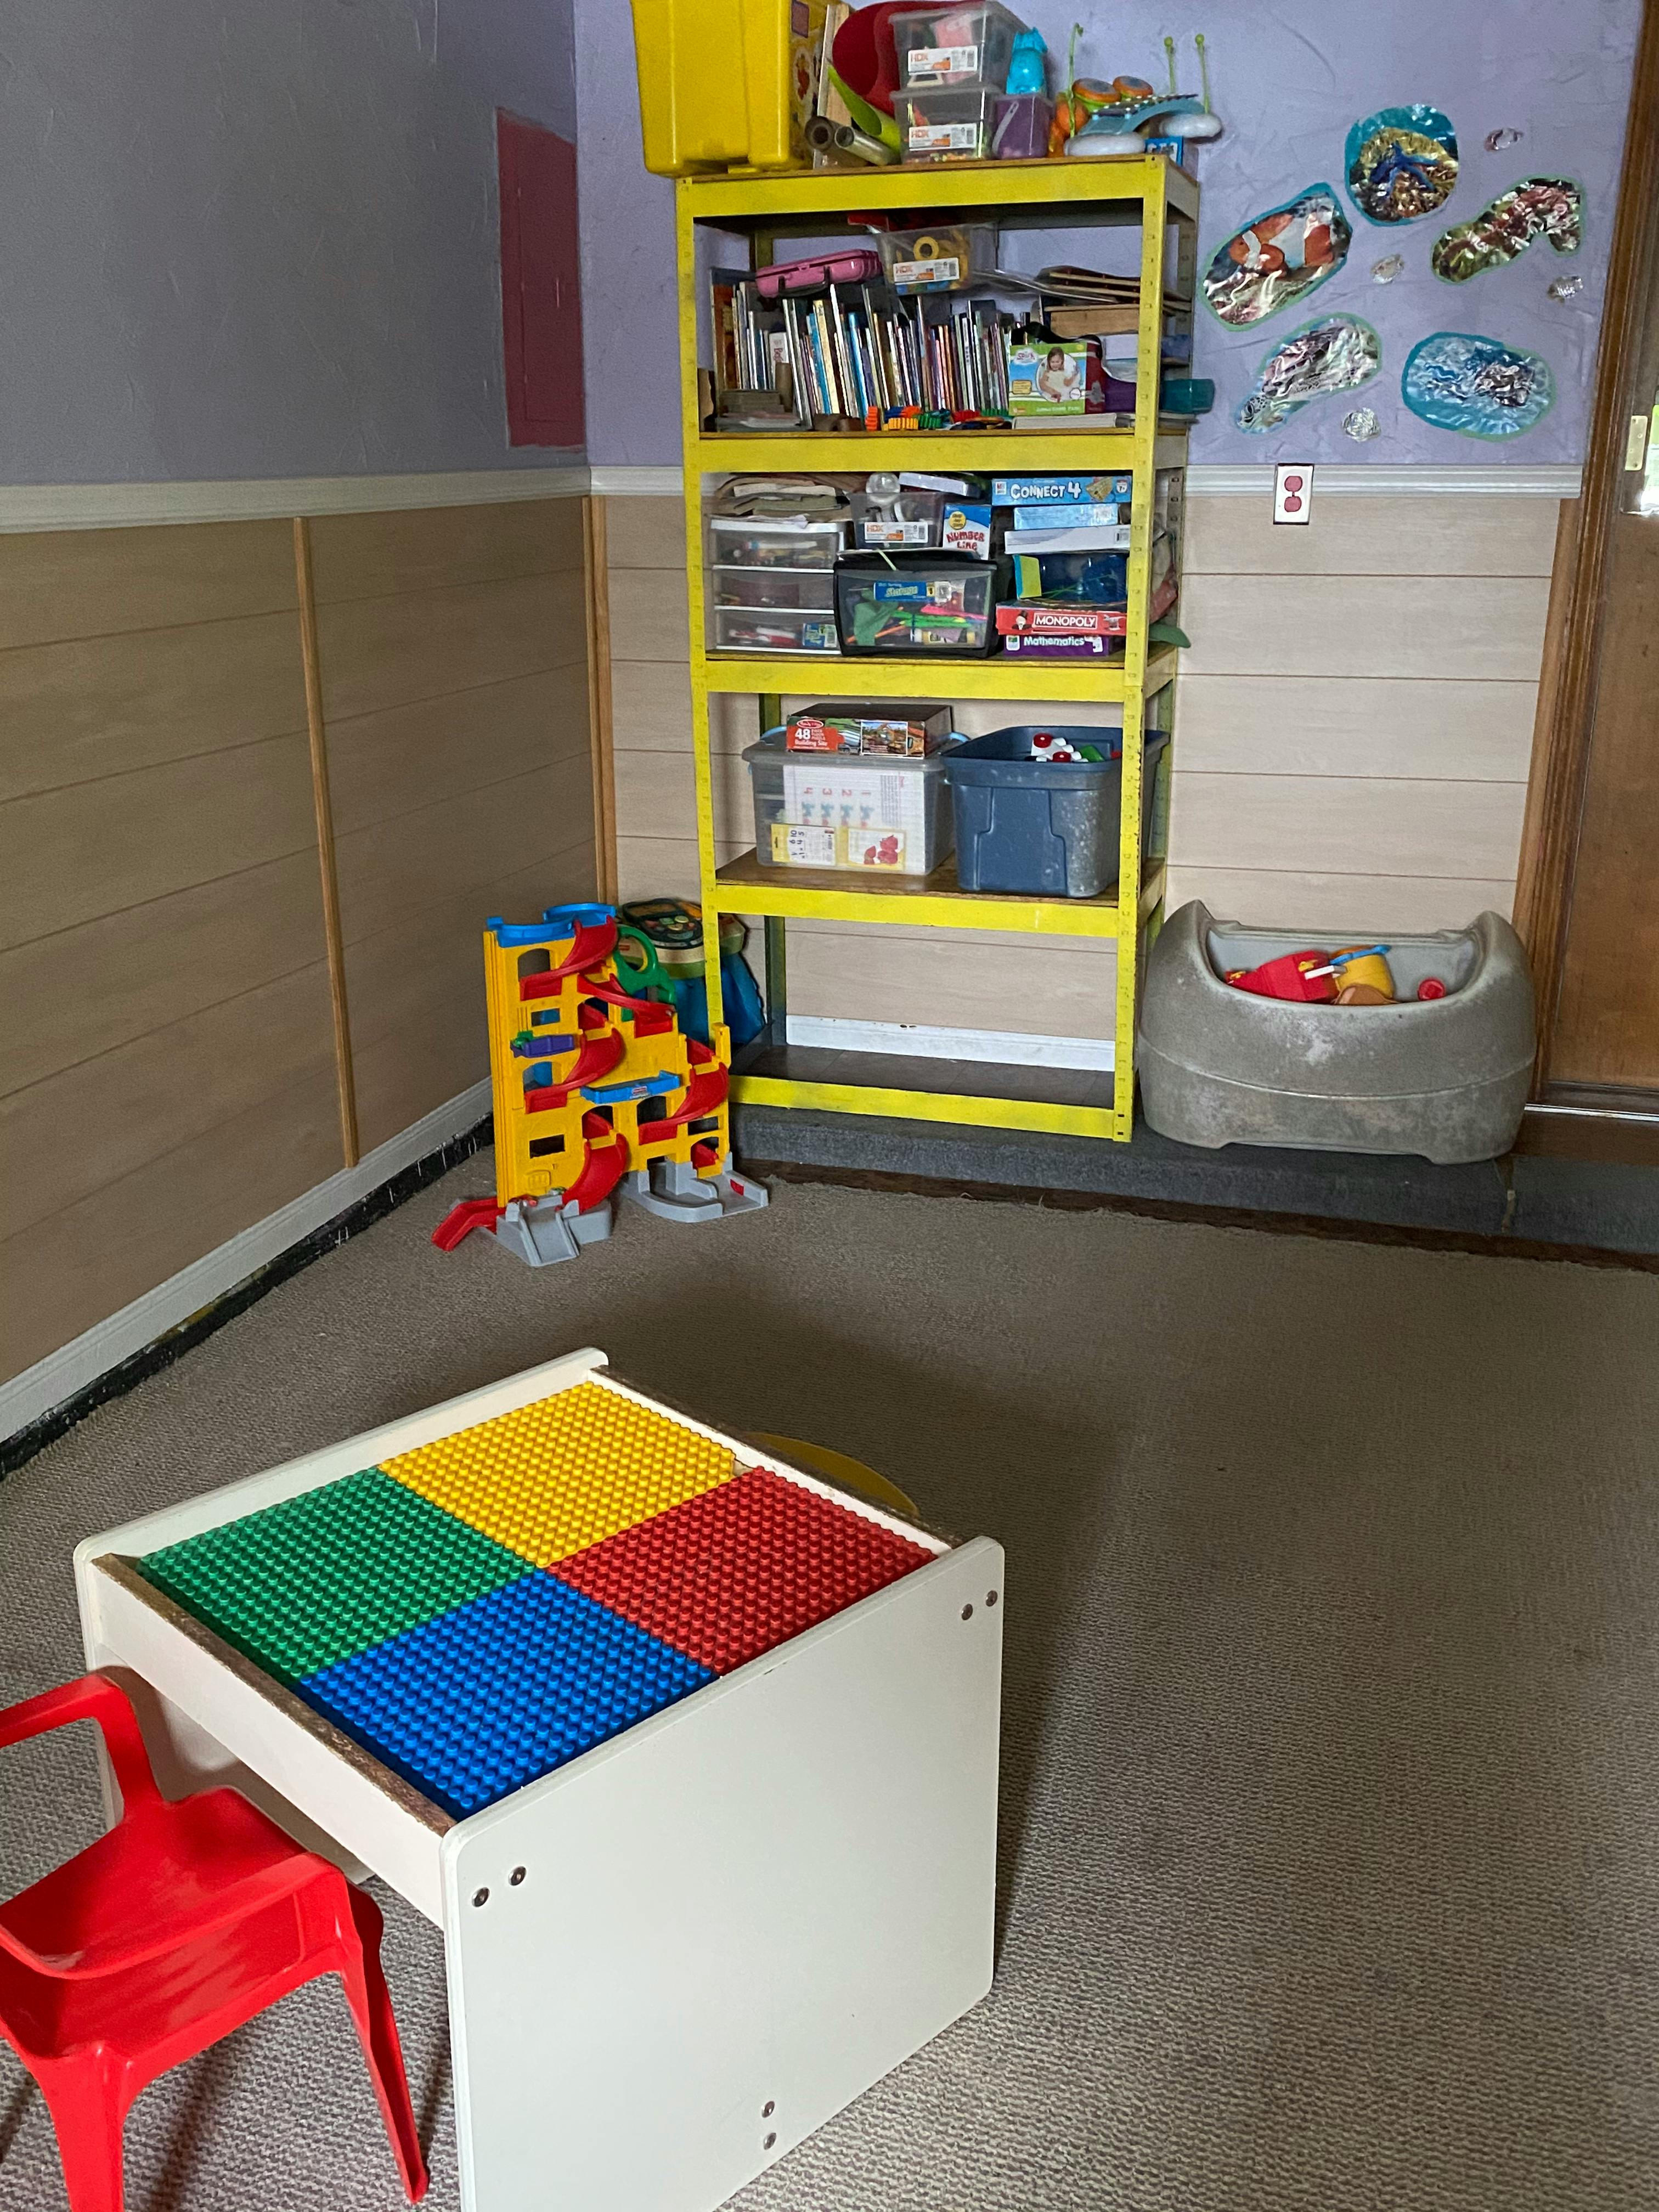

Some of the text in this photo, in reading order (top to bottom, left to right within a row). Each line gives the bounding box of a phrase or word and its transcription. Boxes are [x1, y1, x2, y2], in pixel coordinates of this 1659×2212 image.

[1010, 484, 1065, 499] CONNECT
[1067, 481, 1081, 499] 4
[1036, 615, 1096, 627] MONOPOLY
[1024, 636, 1085, 646] Mathematics
[795, 727, 810, 740] 48
